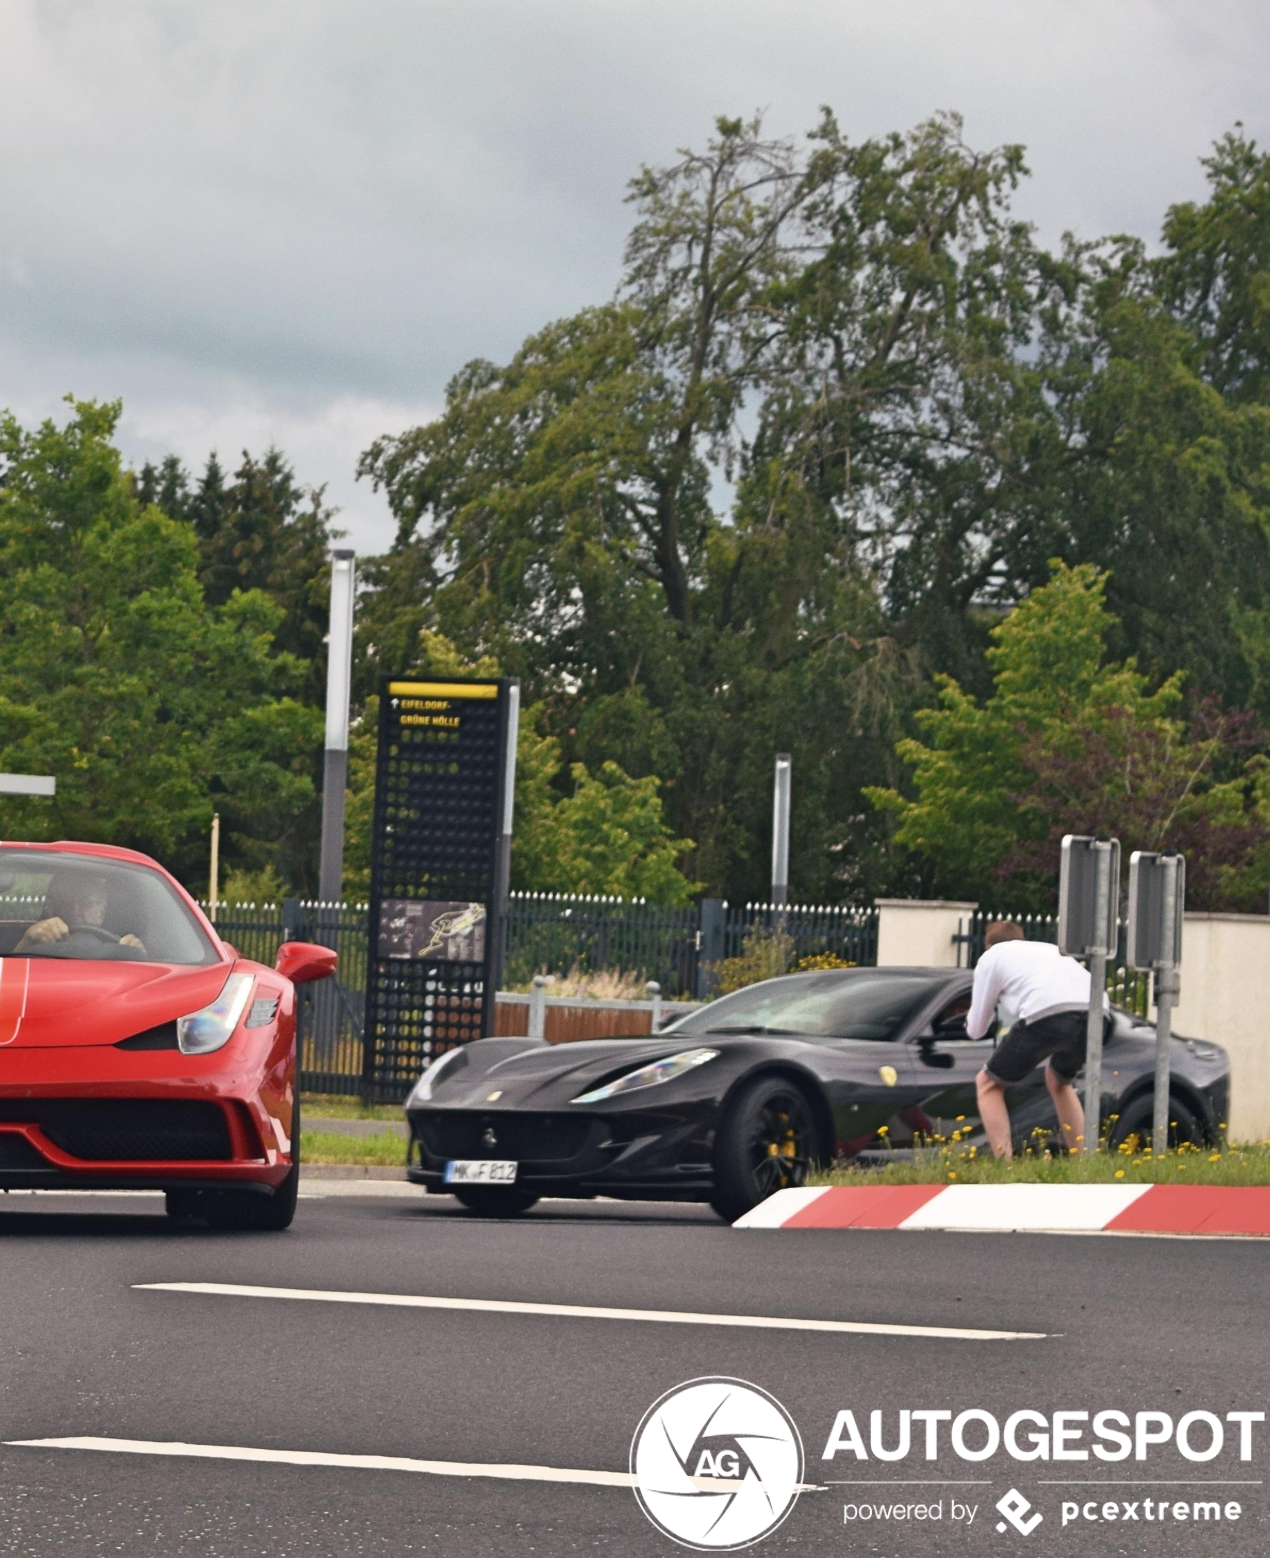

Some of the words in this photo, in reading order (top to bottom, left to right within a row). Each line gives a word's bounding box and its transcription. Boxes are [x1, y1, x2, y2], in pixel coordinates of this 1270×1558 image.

[401, 699, 451, 710] EIFELDORF-
[400, 714, 430, 725] GRÜNE
[432, 715, 460, 727] HÖLLE
